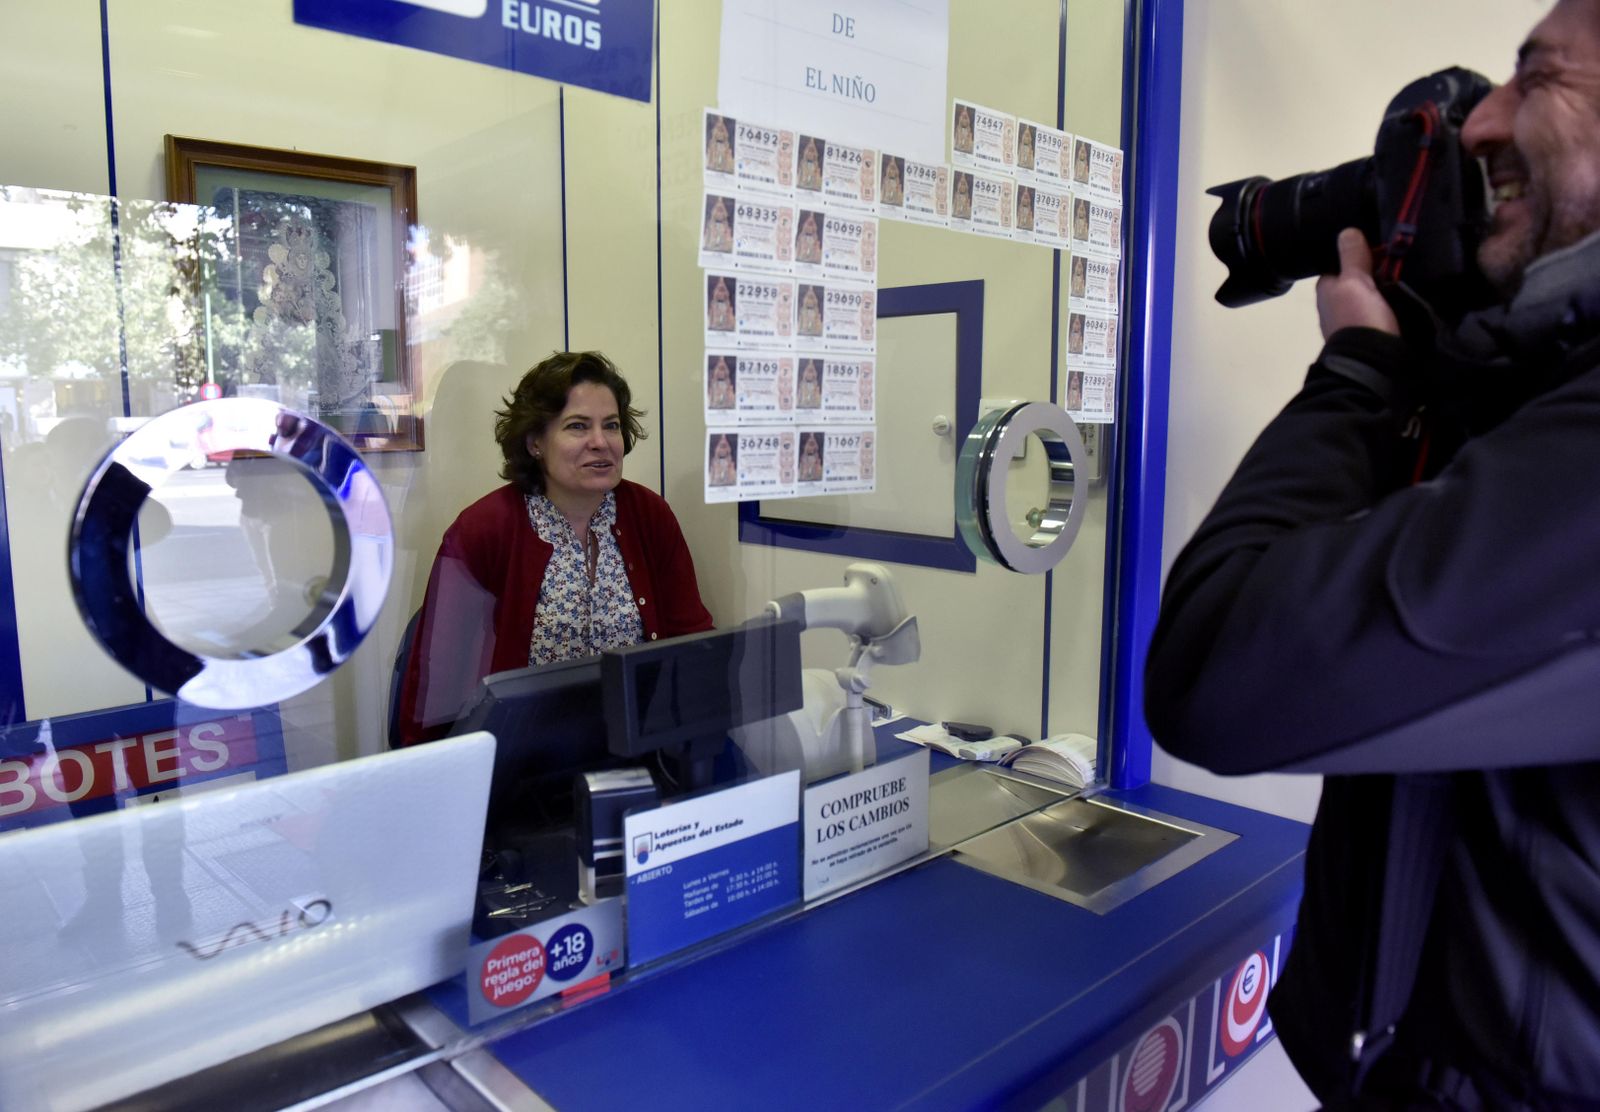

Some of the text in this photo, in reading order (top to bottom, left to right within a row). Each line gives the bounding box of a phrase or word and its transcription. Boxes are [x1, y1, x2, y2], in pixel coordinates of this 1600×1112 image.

[501, 1, 602, 51] EUROS
[831, 12, 855, 39] DE
[805, 66, 876, 104] EL NIÑO
[738, 126, 778, 146] 76492
[827, 146, 862, 163] 81426
[906, 165, 937, 180] 67948
[975, 180, 1002, 195] 45621
[737, 205, 778, 223] 68335
[826, 219, 862, 237] 40699
[738, 284, 778, 298] 22958
[739, 361, 778, 375] 87169
[827, 364, 860, 378] 18561
[741, 437, 780, 450] 36748
[827, 436, 861, 447] 11667
[820, 777, 907, 820] COMPRUEBE
[817, 797, 911, 844] LOS CAMBIOS
[655, 819, 744, 852] Apuestas del Estado
[637, 864, 674, 885] ABIERTO
[550, 932, 586, 958] +18
[487, 946, 540, 974] Primera
[553, 953, 584, 972] años
[484, 955, 544, 988] regla del
[493, 973, 537, 1001] juego:
